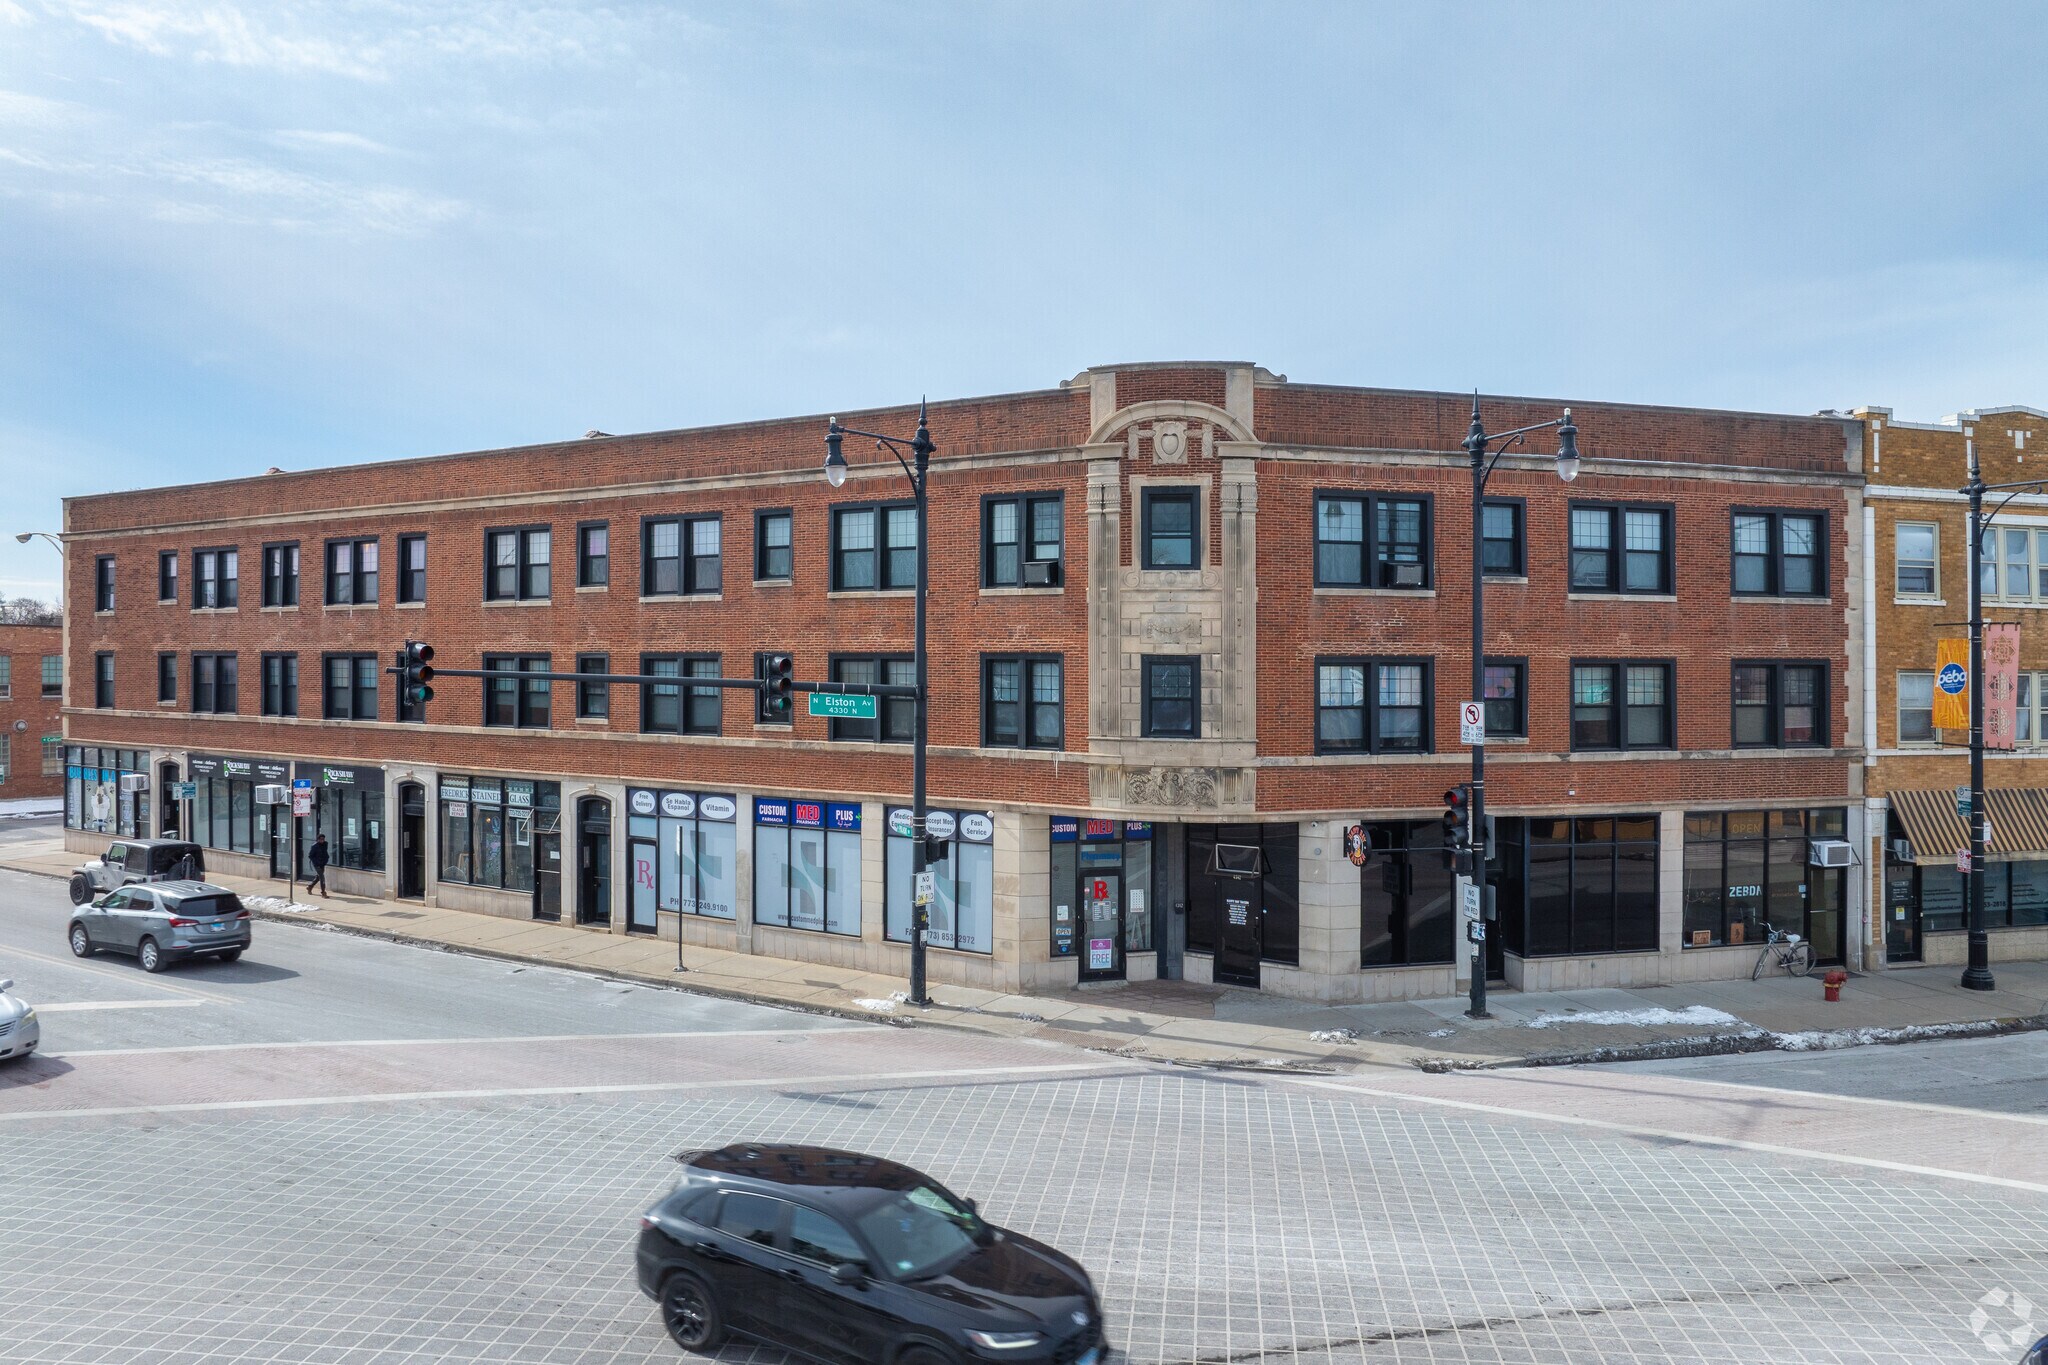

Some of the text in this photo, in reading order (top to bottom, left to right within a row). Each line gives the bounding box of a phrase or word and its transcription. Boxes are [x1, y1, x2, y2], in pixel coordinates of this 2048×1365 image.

[826, 697, 855, 706] Elston
[472, 790, 500, 801] STAINED
[510, 794, 530, 804] GLASS
[668, 804, 690, 812] Espanol
[706, 804, 730, 812] Vitamin
[759, 804, 786, 816] CUSTOM
[796, 804, 820, 820] MED
[836, 810, 854, 820] PLUS
[926, 817, 941, 826] Accept
[966, 828, 987, 836] Service
[1086, 820, 1113, 834] MED
[1126, 822, 1142, 830] PLUS
[1732, 824, 1760, 834] OPEN
[1466, 897, 1476, 906] TURN
[1092, 954, 1110, 964] FREE
